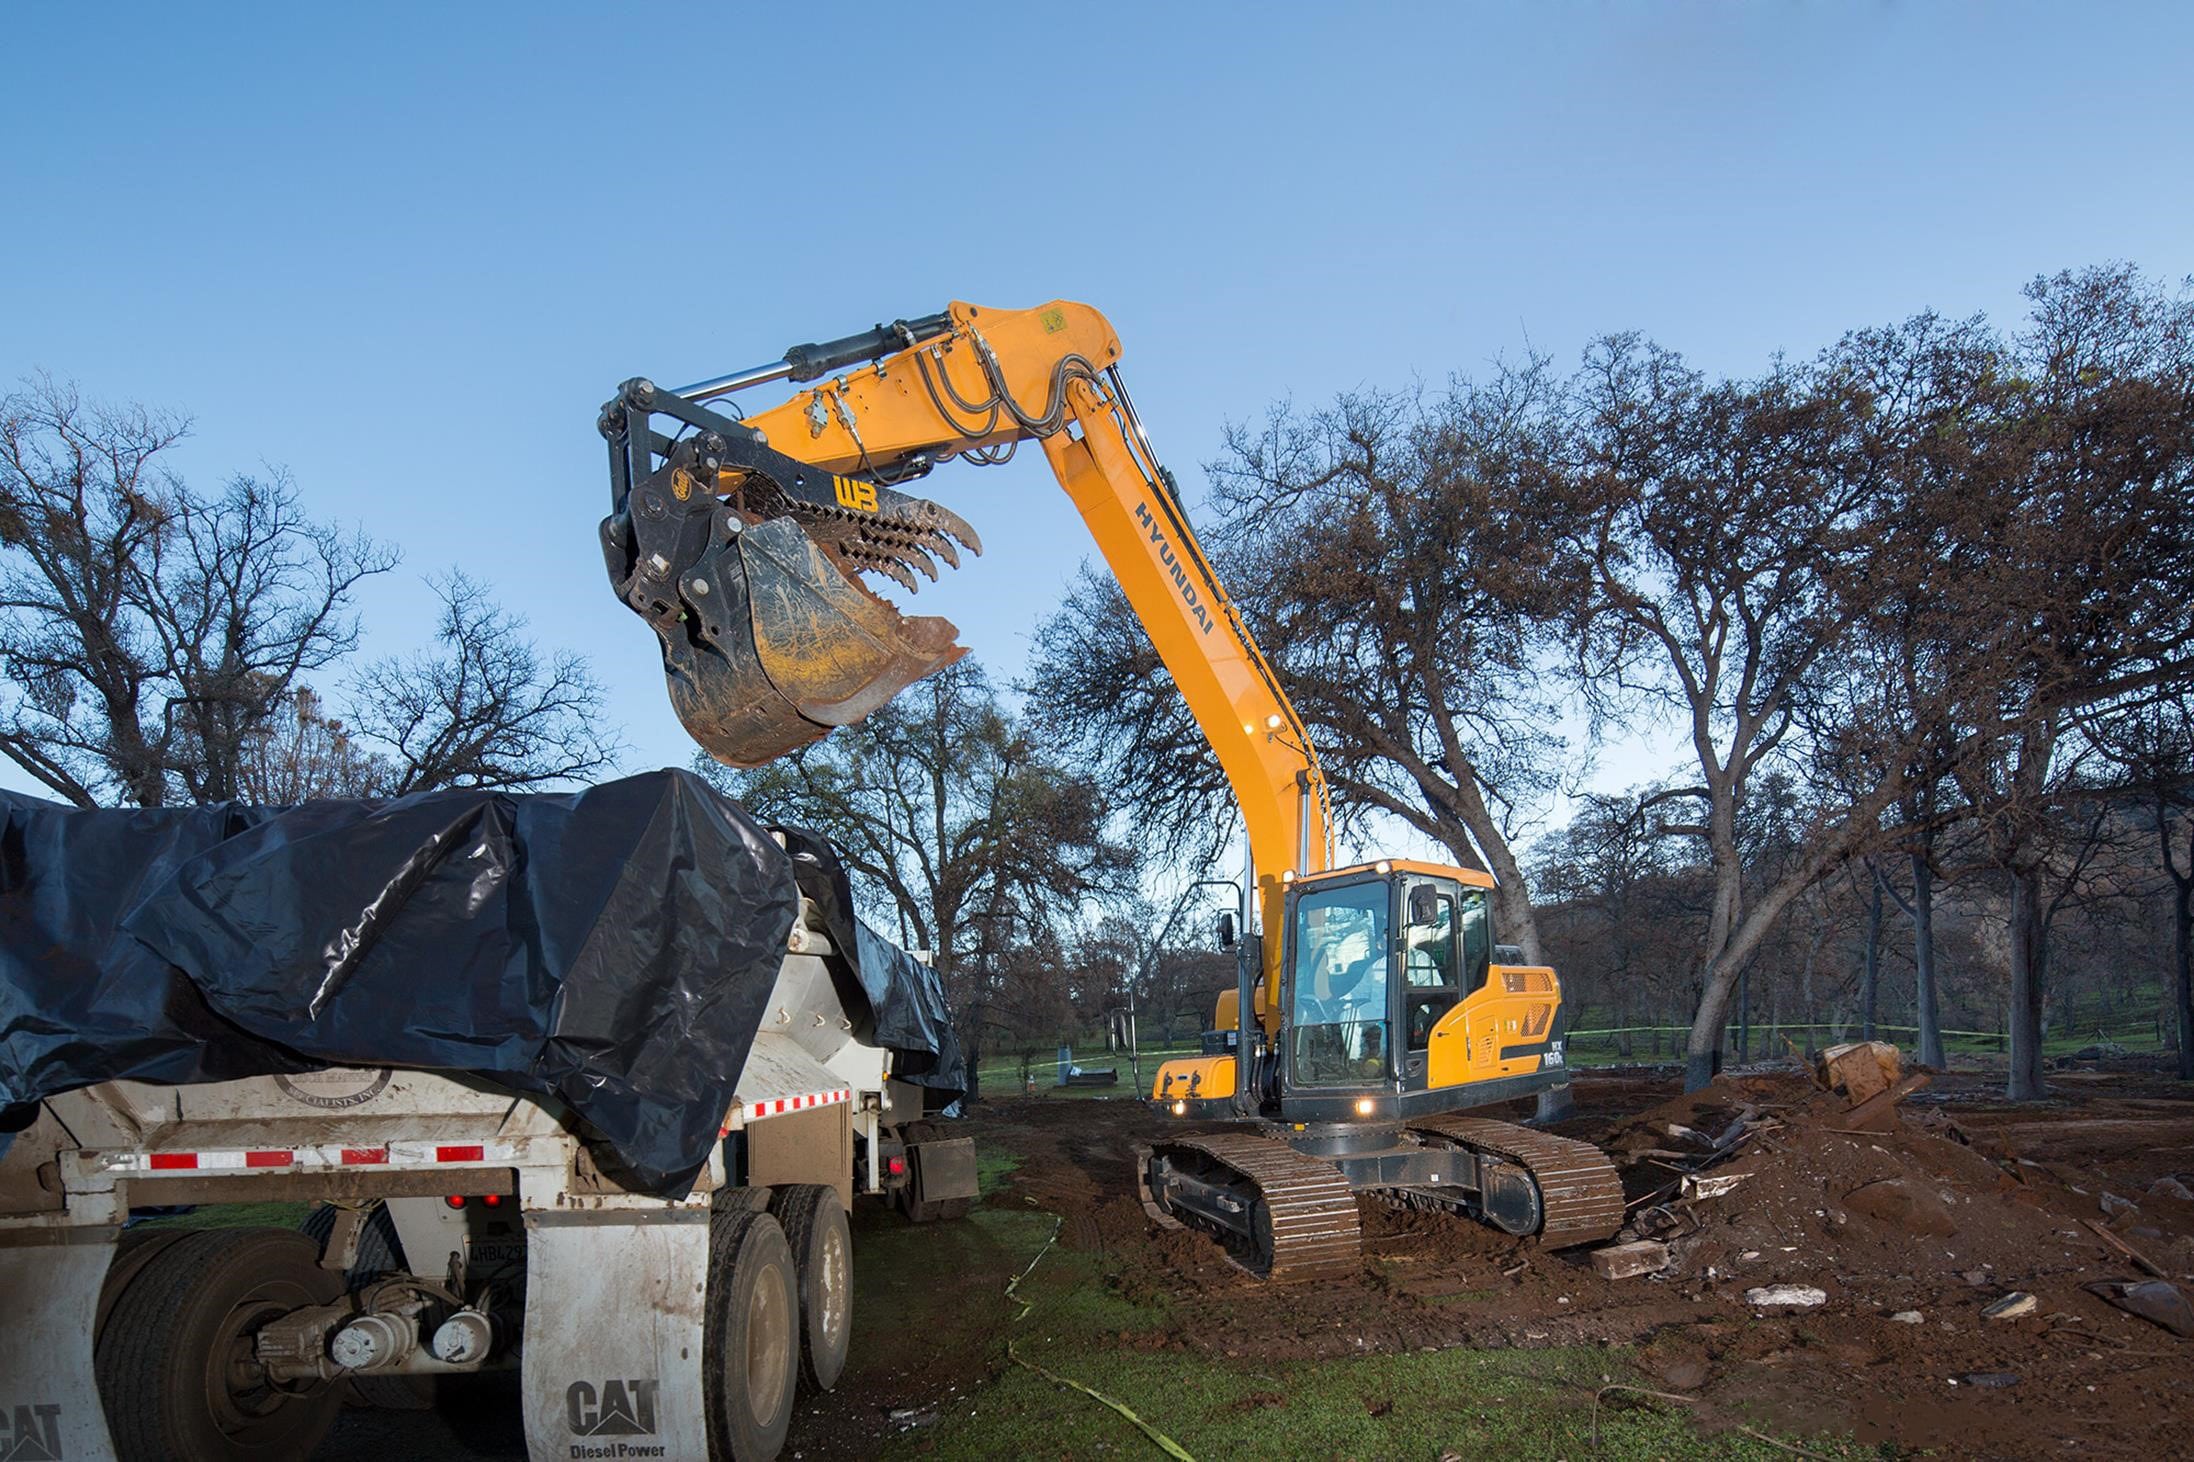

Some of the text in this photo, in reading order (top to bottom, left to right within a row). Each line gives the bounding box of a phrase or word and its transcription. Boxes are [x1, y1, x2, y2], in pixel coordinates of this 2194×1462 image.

[833, 475, 879, 513] WB
[1135, 502, 1214, 635] HYUNDAI
[566, 1380, 660, 1436] CAT
[570, 1443, 666, 1459] Diesel Power
